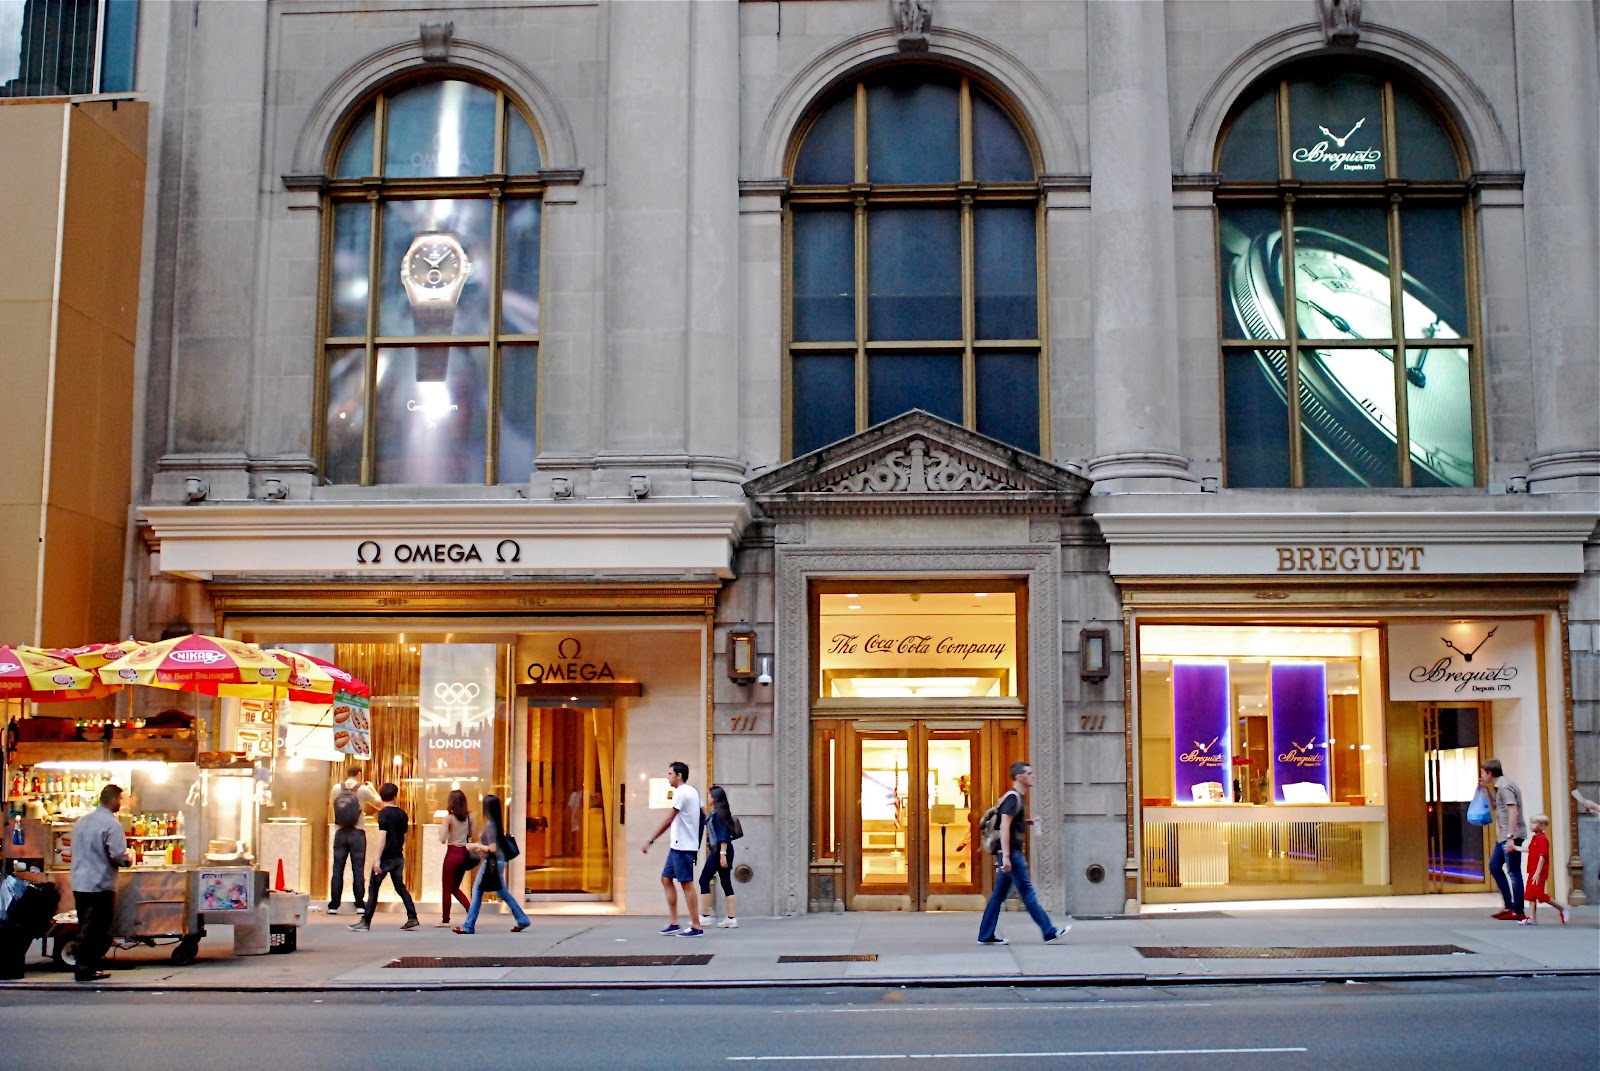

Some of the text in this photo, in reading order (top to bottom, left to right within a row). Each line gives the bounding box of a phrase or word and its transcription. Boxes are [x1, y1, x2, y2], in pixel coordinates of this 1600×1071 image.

[411, 152, 470, 168] OMA
[1293, 141, 1381, 171] Breguet
[394, 543, 482, 563] OMEGA
[1276, 547, 1425, 571] BREGUET
[828, 633, 1007, 660] The Coca-Cola Company
[177, 651, 213, 661] NIKAS
[174, 672, 193, 680] Beef
[195, 672, 234, 681] Sausages
[527, 662, 615, 682] OMEGA
[1409, 656, 1518, 692] Breguet
[731, 715, 757, 731] 711
[1081, 714, 1105, 730] 711
[429, 739, 480, 749] LONDON
[429, 749, 480, 768] 2012
[1180, 749, 1226, 767] Breguet
[1278, 750, 1324, 767] Breguet
